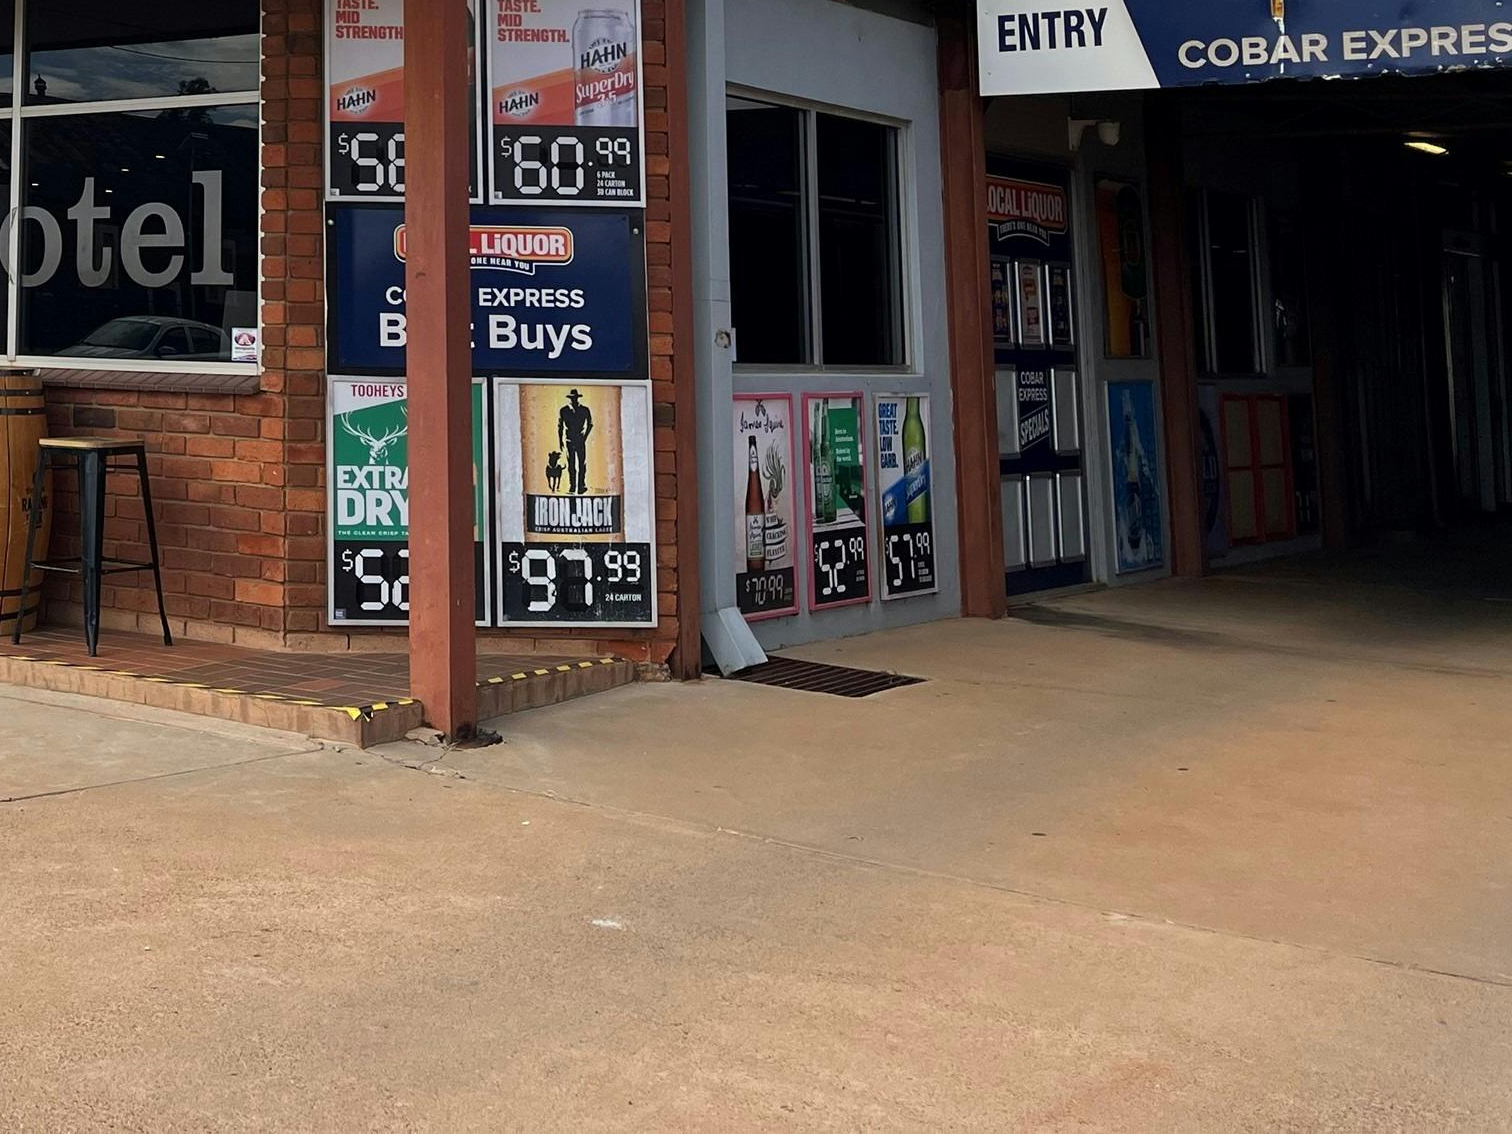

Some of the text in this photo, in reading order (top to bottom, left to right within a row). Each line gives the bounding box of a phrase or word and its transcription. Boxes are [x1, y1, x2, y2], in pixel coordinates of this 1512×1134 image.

[497, 0, 542, 13] TASTE.
[336, 11, 360, 25] MID
[497, 14, 522, 27] MID
[497, 29, 570, 43] STRENGTH.
[997, 7, 1108, 53] ENTRY
[581, 42, 627, 69] HAHN
[1178, 33, 1329, 69] COBAR
[337, 89, 376, 111] HAHN
[499, 92, 539, 114] HAHN
[601, 171, 615, 179] PACK
[597, 179, 625, 187] 24 CARTON
[597, 188, 604, 196] 30
[617, 188, 634, 197] BLOCK
[987, 185, 1020, 216] OCAL
[470, 257, 530, 270] ONE NEAR YOU
[478, 287, 585, 308] EXPRESS
[489, 314, 593, 360] Buys
[1020, 371, 1044, 384] COBAR
[351, 384, 404, 397] TOOHEYS
[1019, 388, 1048, 401] EXPRESS
[1020, 409, 1049, 445] SPECIALS
[534, 496, 613, 527] IRON JACK
[508, 549, 641, 611] $97.99
[615, 594, 642, 602] CARTON
